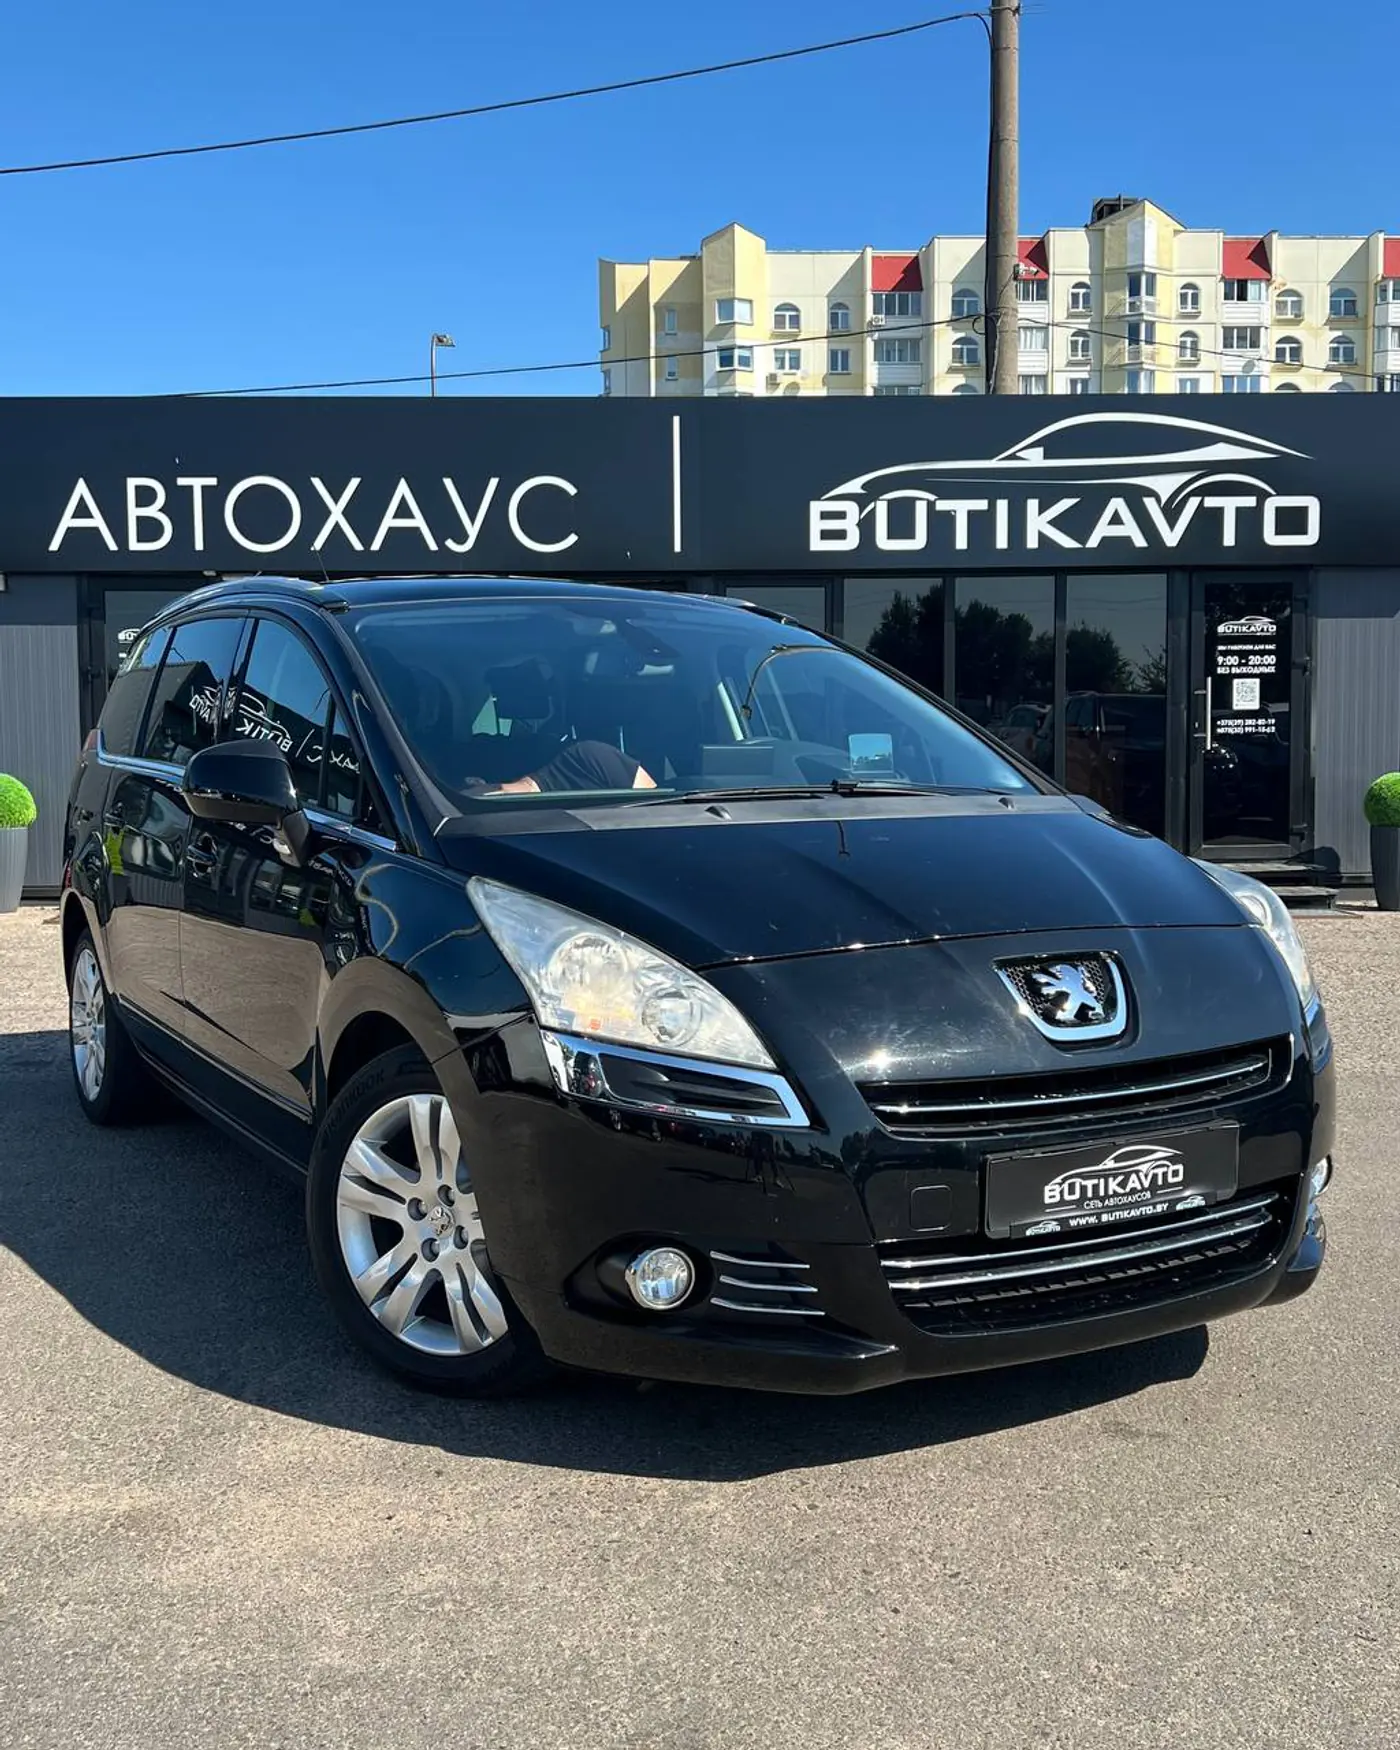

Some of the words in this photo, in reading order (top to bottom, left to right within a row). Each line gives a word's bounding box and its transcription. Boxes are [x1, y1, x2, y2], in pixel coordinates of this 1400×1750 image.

[48, 475, 579, 553] АВТОХАУС
[809, 495, 1320, 552] BUTIKAVTO
[1217, 624, 1277, 633] BUTIKAVTO
[1217, 656, 1239, 665] 9:00
[1248, 655, 1276, 665] 20:00
[1044, 1163, 1184, 1204] BUTIKAVTO
[1083, 1199, 1103, 1209] СЕТЬ
[1104, 1191, 1152, 1207] АВТОХАУСОВ
